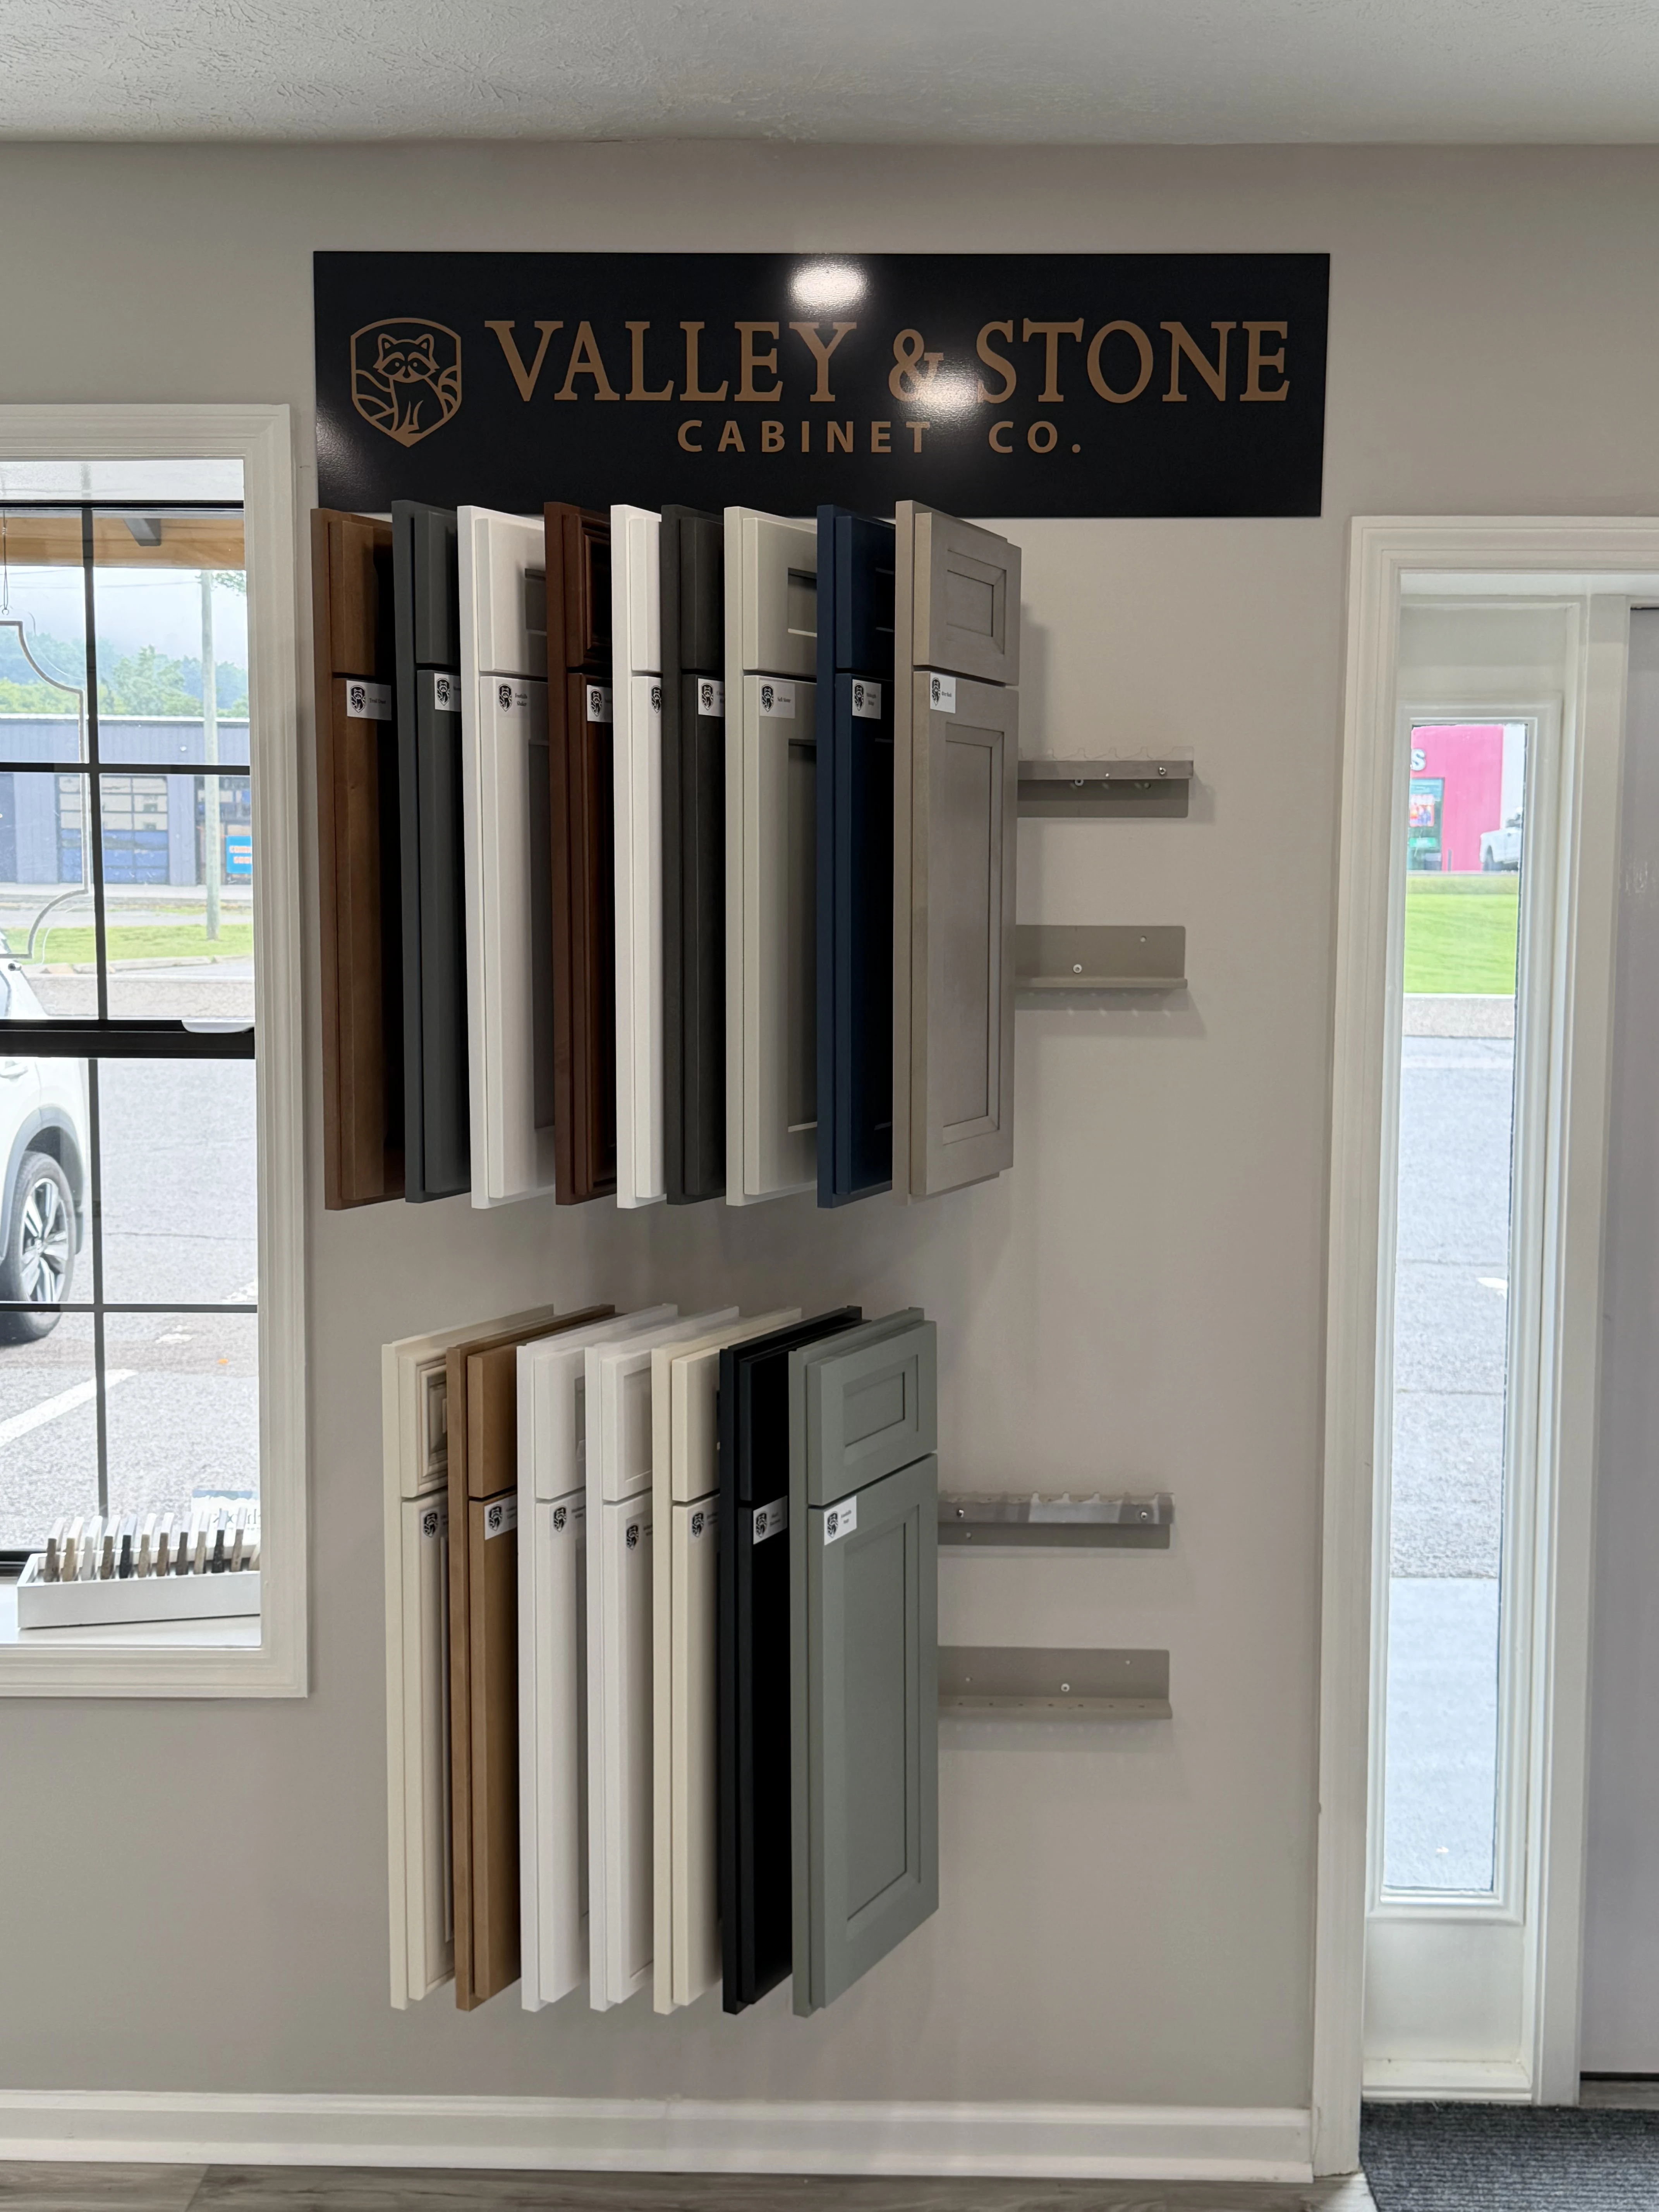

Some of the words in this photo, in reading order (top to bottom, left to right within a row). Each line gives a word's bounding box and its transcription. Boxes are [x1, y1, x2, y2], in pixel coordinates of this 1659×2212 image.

[485, 321, 855, 402] VALLEY
[888, 328, 945, 403] &
[976, 318, 1289, 404] STONE
[677, 420, 930, 453] CABINET
[988, 421, 1080, 453] CO.
